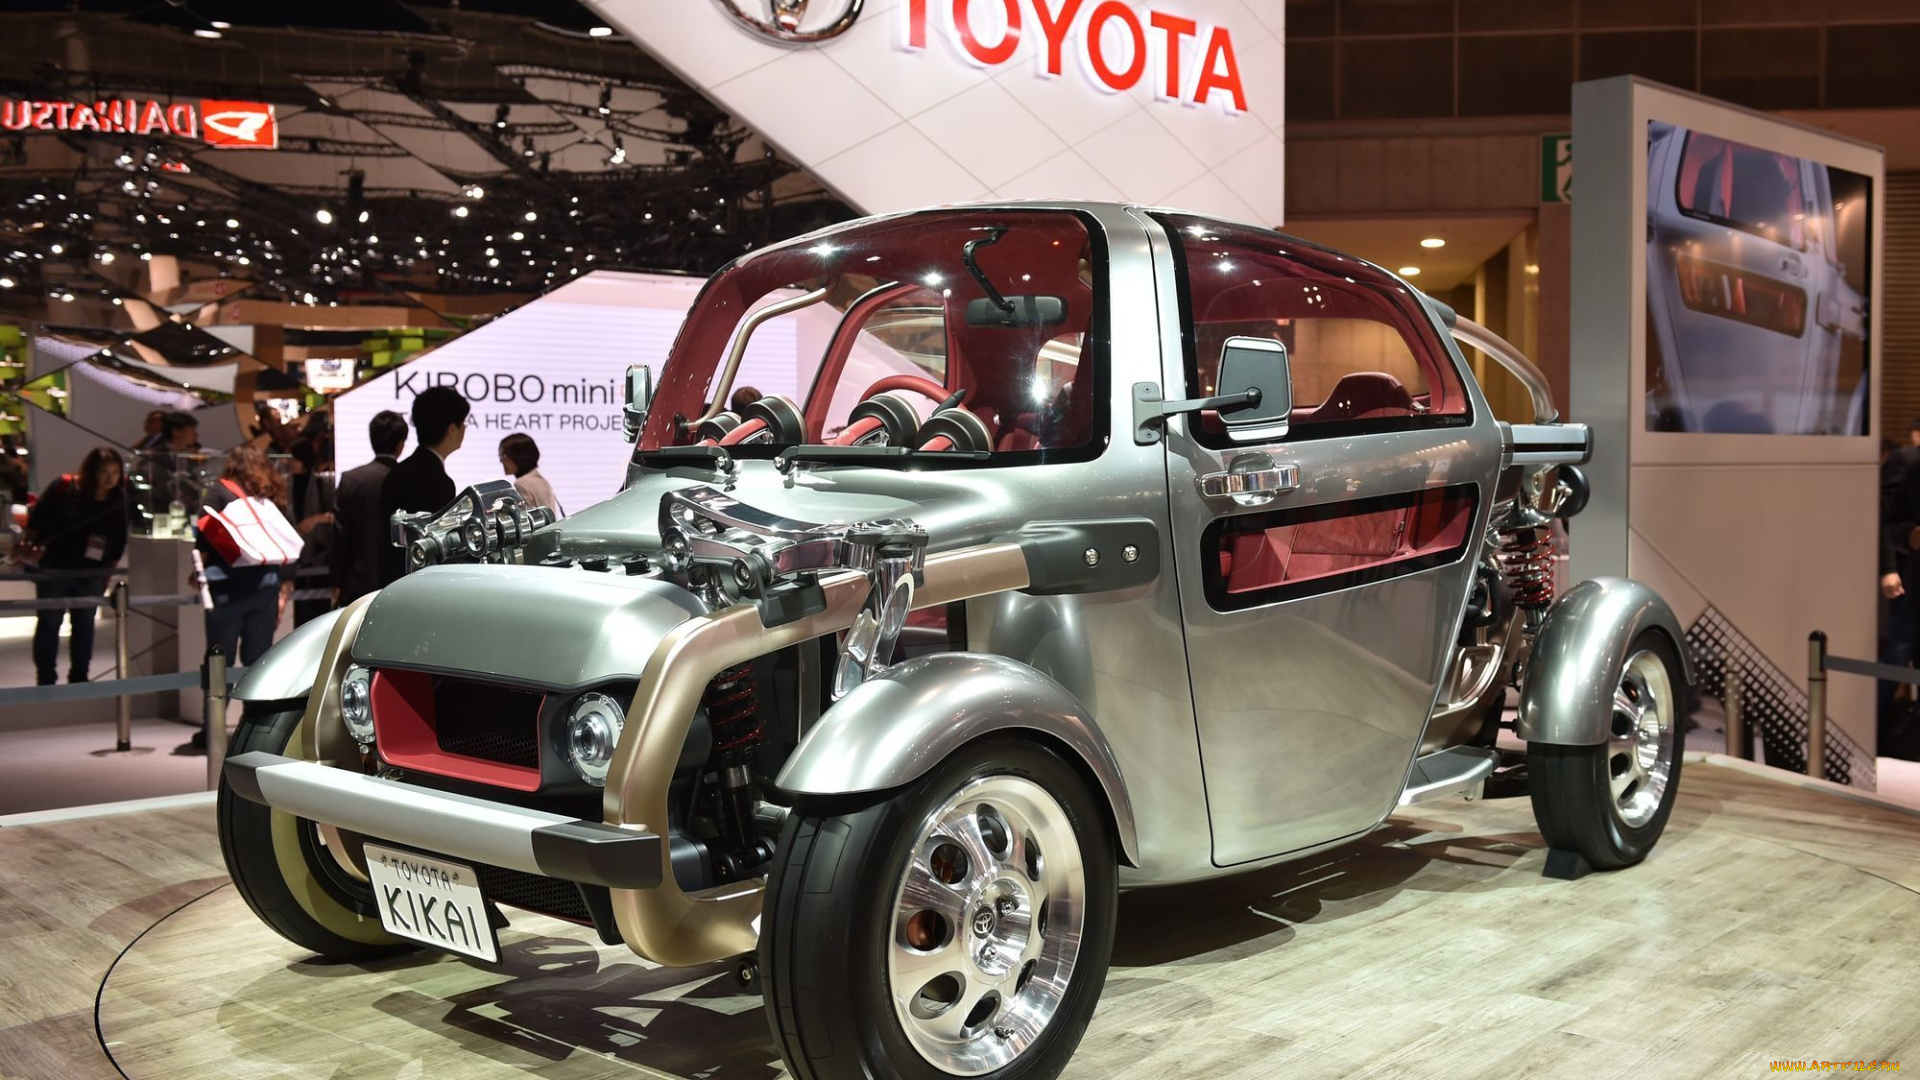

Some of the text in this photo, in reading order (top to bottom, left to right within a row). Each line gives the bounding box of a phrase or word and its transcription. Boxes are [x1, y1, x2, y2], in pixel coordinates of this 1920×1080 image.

[552, 378, 615, 404] mini
[486, 412, 554, 430] HEART
[559, 414, 625, 431] PROJE
[391, 858, 453, 891] TOYOTA
[383, 884, 481, 950] KIKAI
